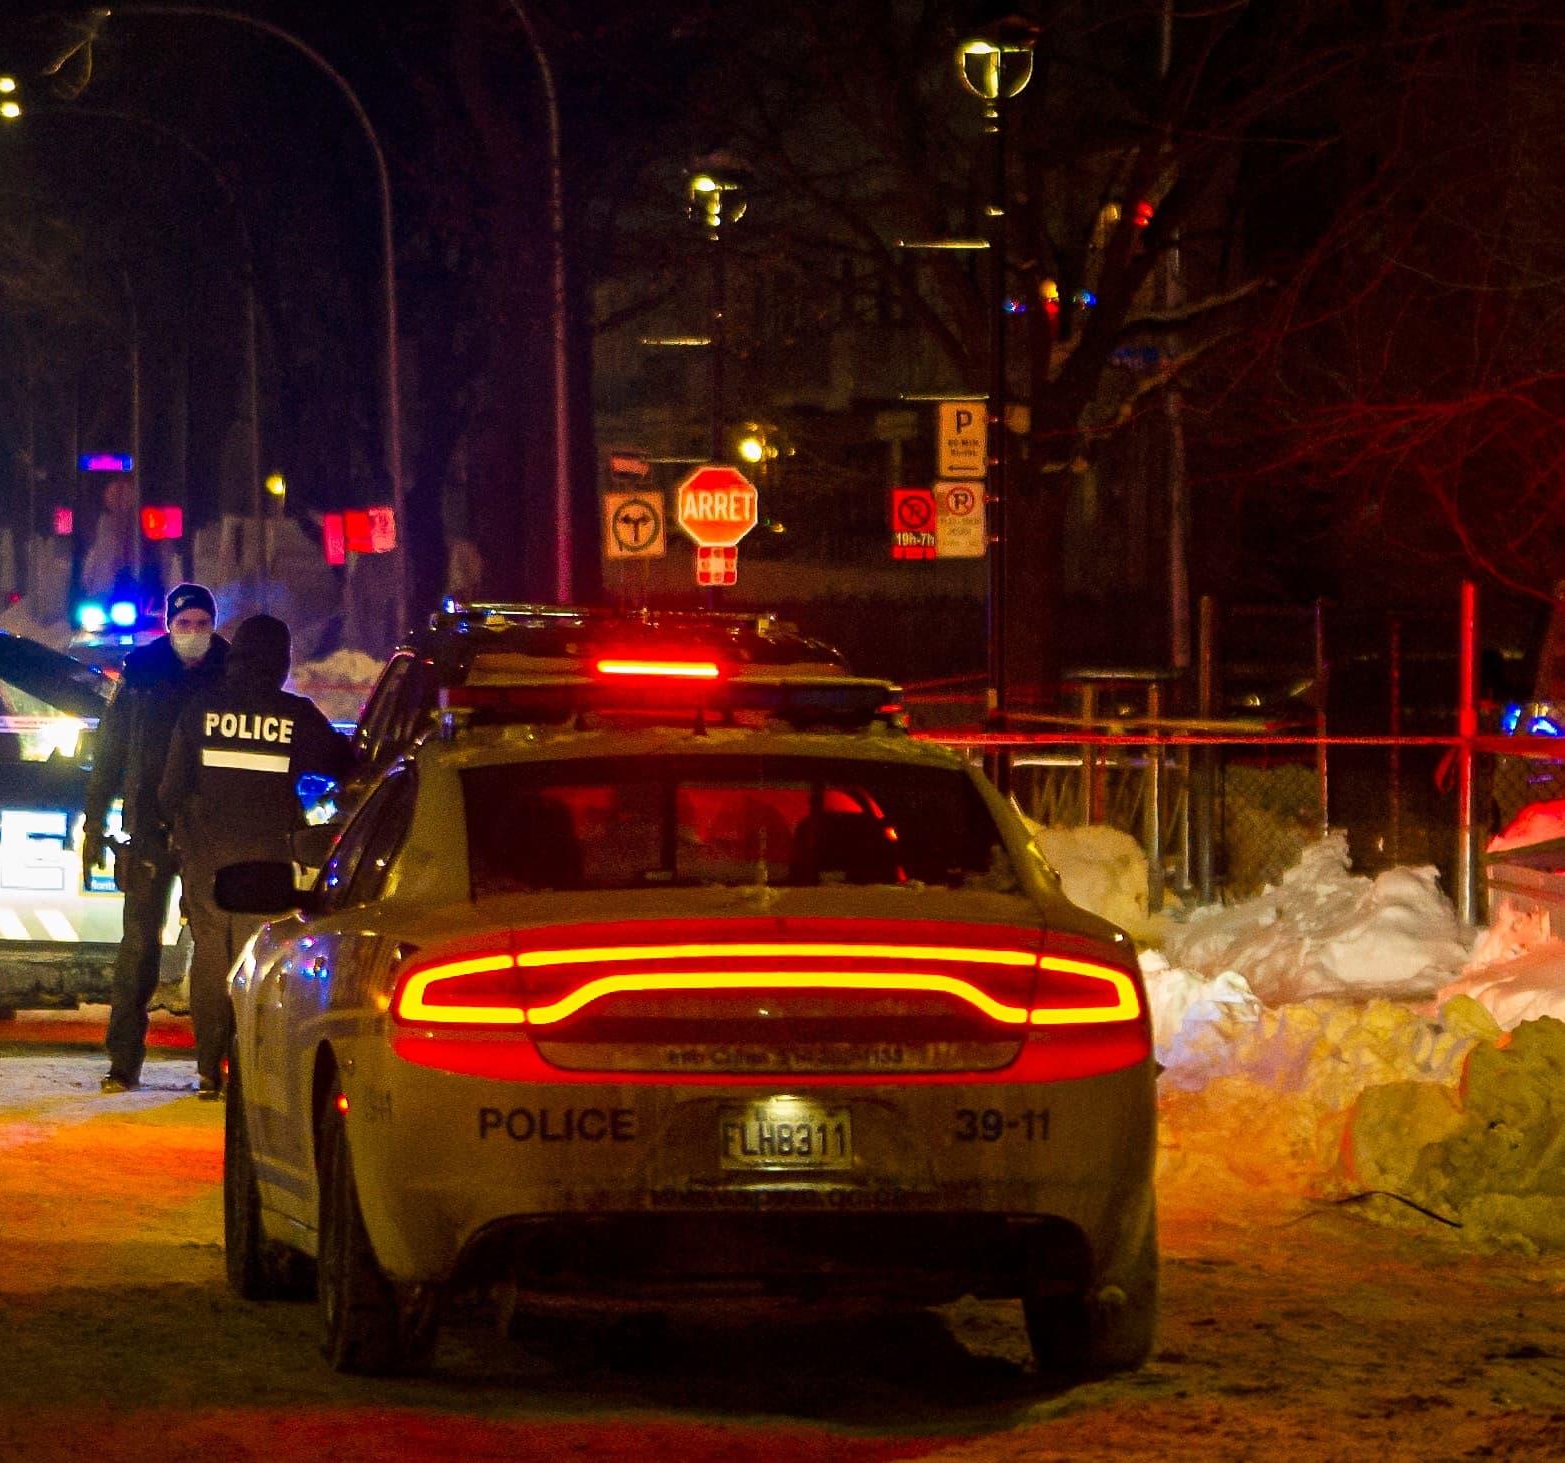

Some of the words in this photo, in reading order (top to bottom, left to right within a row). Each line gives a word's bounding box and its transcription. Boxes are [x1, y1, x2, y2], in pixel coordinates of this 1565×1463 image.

[205, 712, 294, 744] POLICE
[479, 1107, 637, 1142] POLICE
[723, 1121, 845, 1156] FLH8311
[955, 1108, 1050, 1141] 39-11
